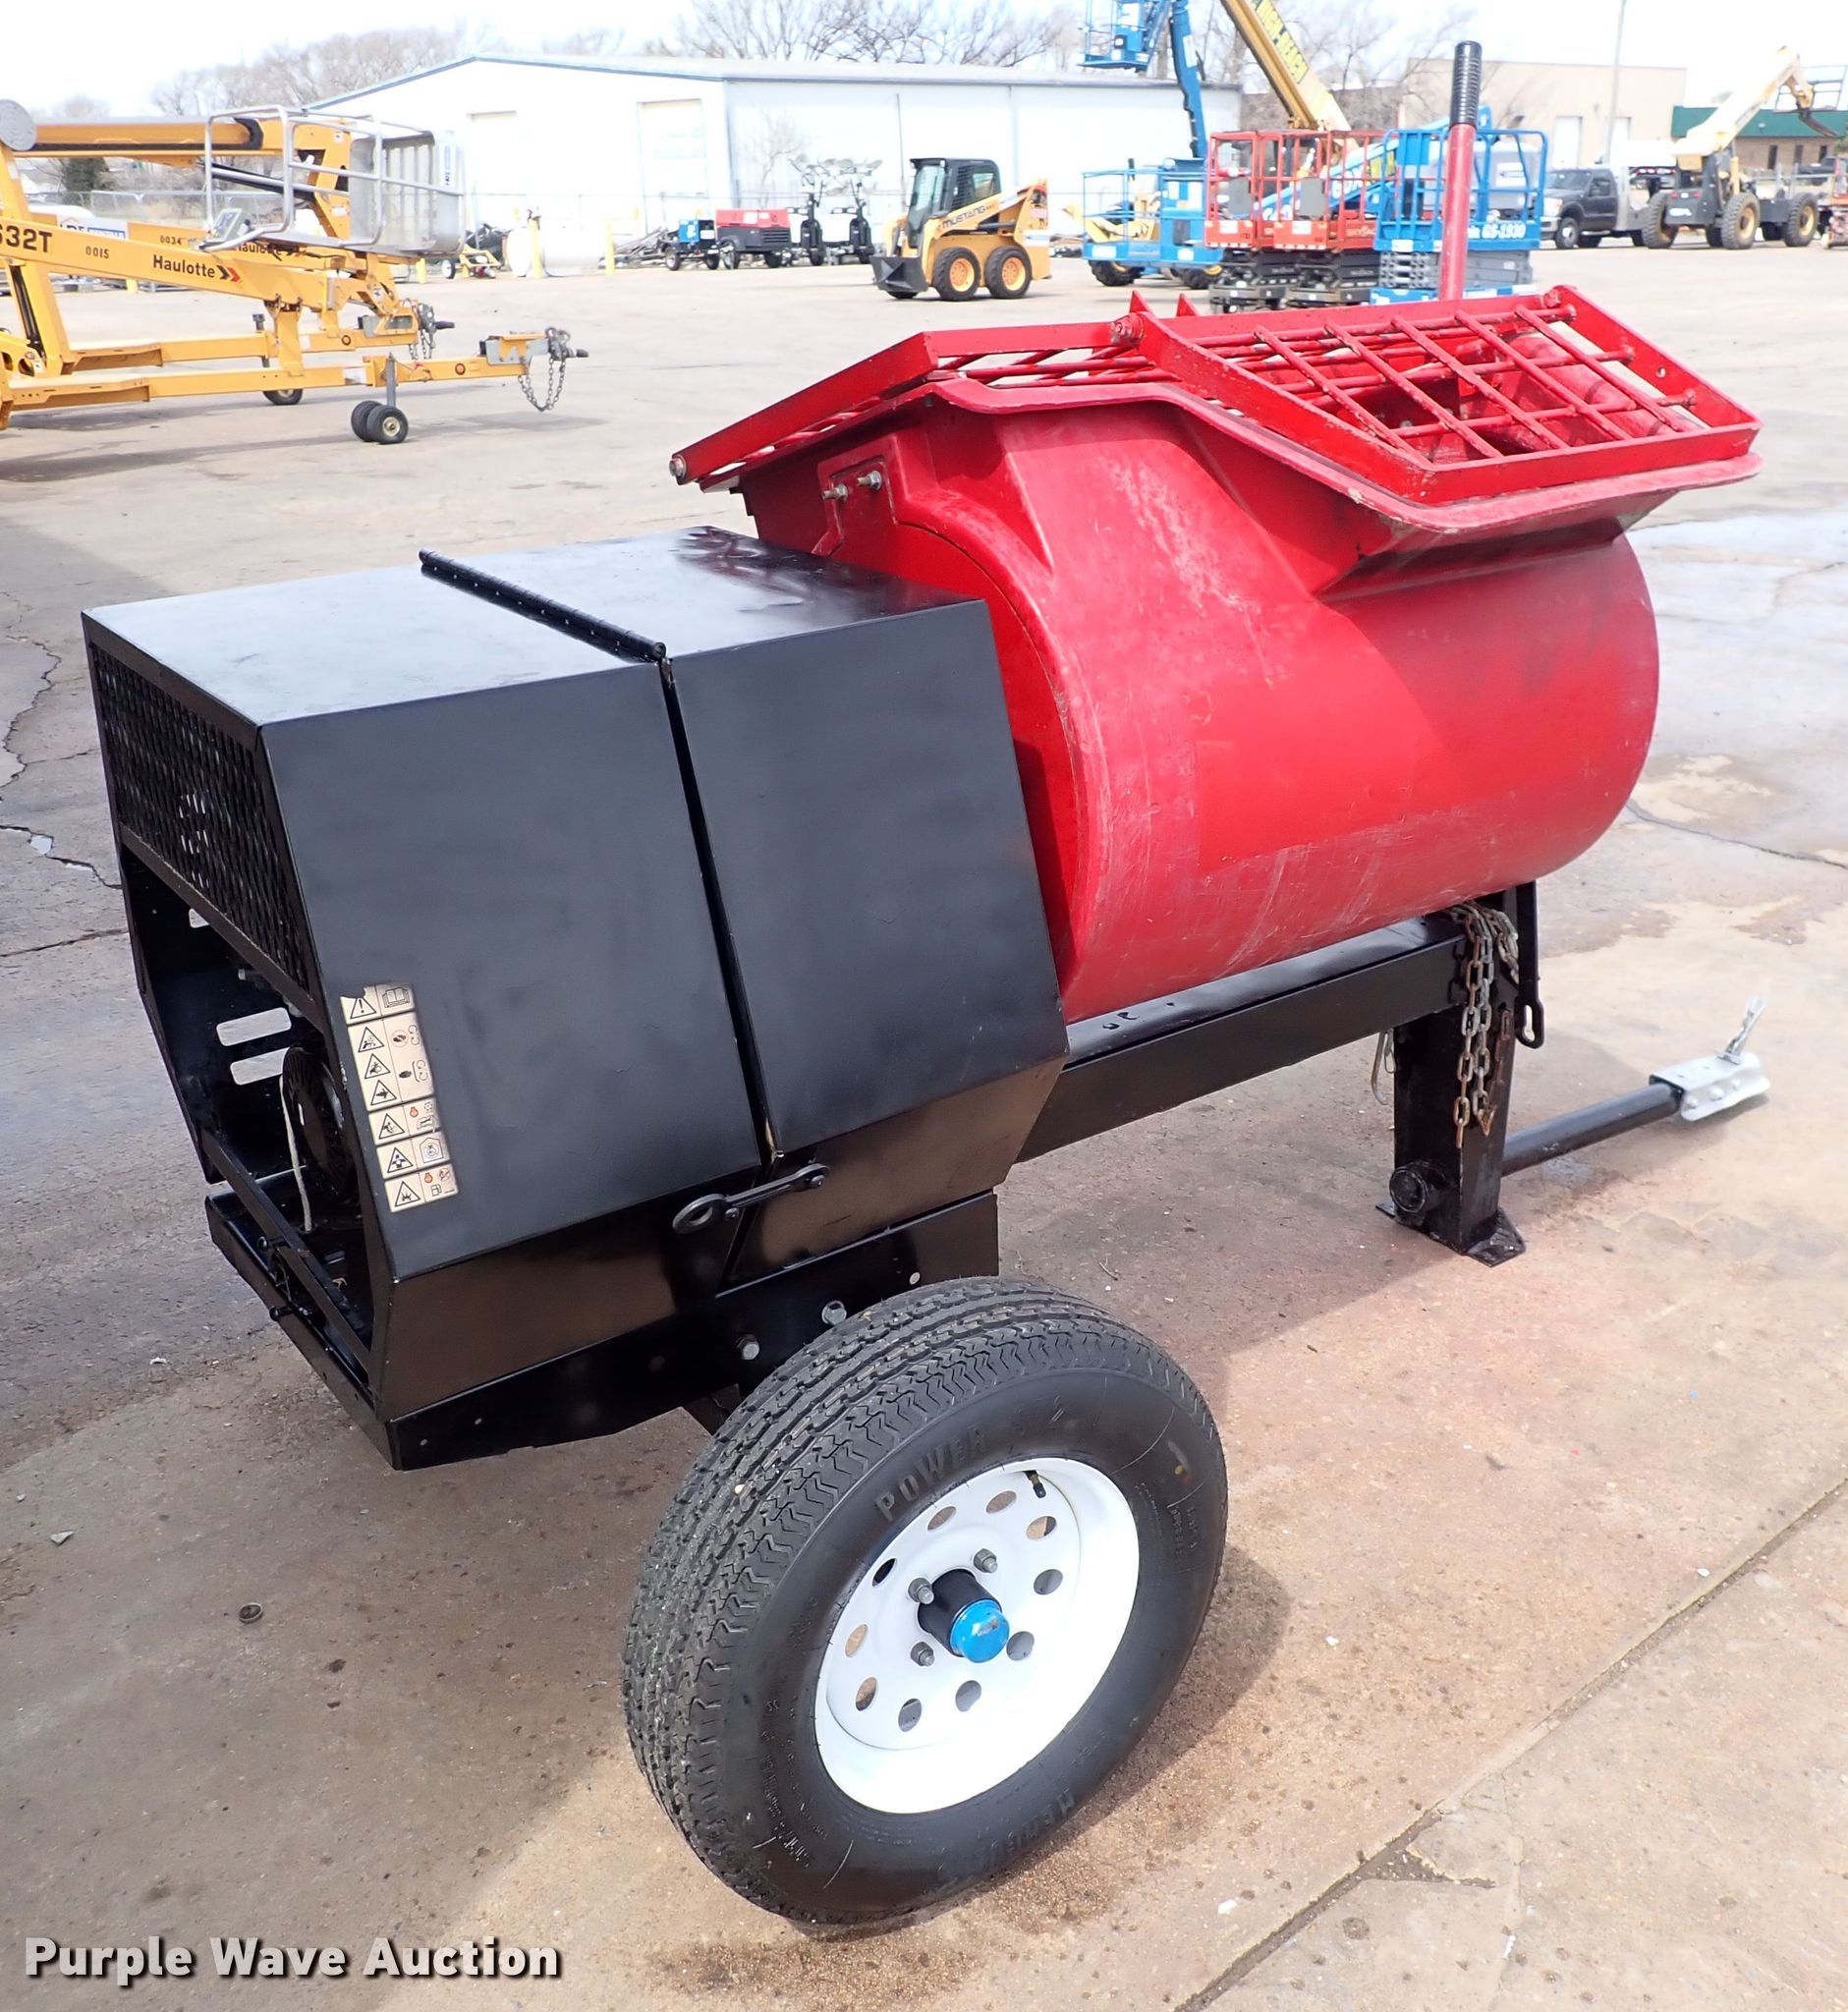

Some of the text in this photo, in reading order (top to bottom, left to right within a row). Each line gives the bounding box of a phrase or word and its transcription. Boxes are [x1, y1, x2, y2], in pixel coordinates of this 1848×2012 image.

[943, 204, 986, 229] MUSTANG
[0, 224, 52, 253] 32T
[84, 246, 110, 259] 0015
[153, 253, 215, 279] Haulotte
[873, 1425, 987, 1522] POWER
